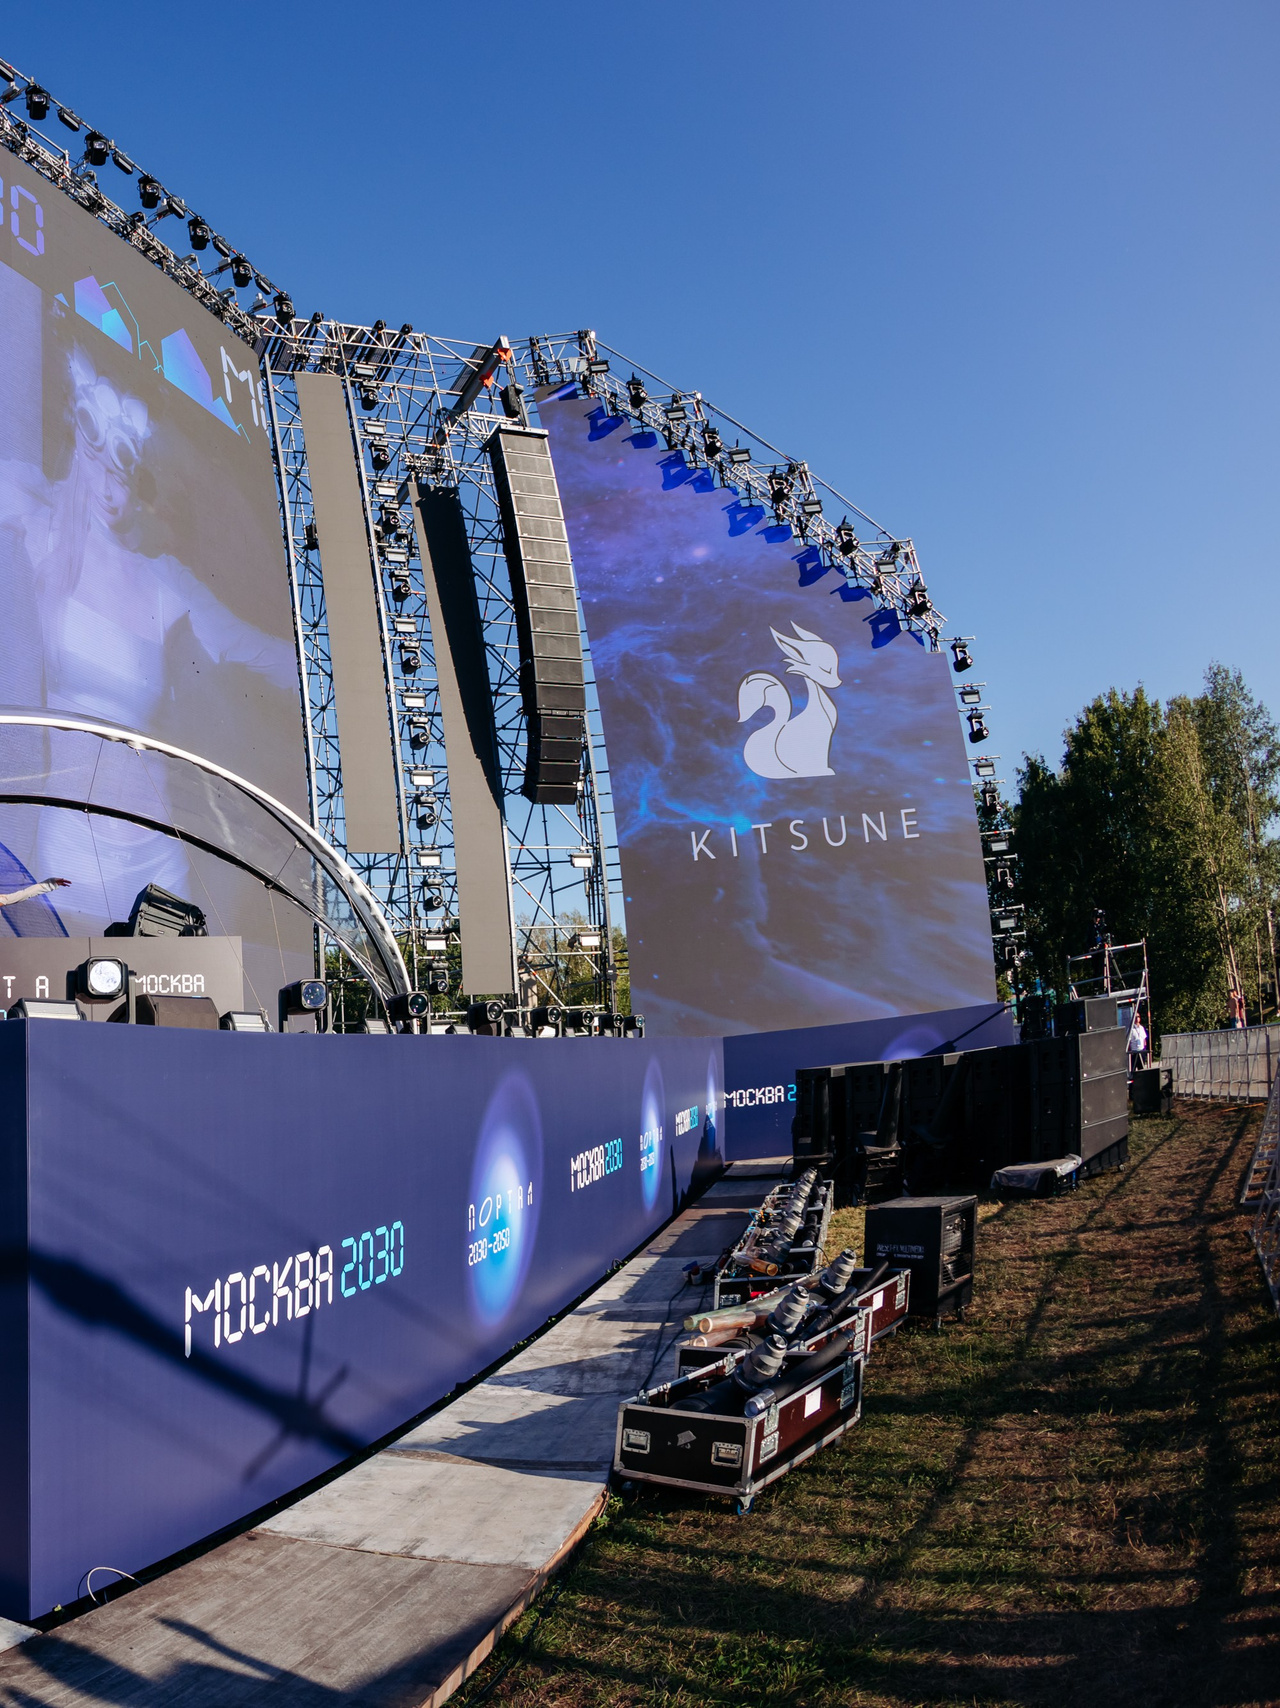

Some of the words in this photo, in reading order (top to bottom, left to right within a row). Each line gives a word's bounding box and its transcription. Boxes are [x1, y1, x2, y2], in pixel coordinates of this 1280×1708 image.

[691, 808, 920, 861] KITSUNE
[723, 1085, 784, 1108] МОСКВА
[570, 1144, 605, 1192] МОСКВА
[604, 1137, 623, 1175] 2030
[468, 1181, 533, 1232] ПОРТАЛ
[468, 1227, 510, 1266] 2030-2050
[185, 1244, 333, 1358] МОСКВА
[340, 1220, 404, 1298] 2030
